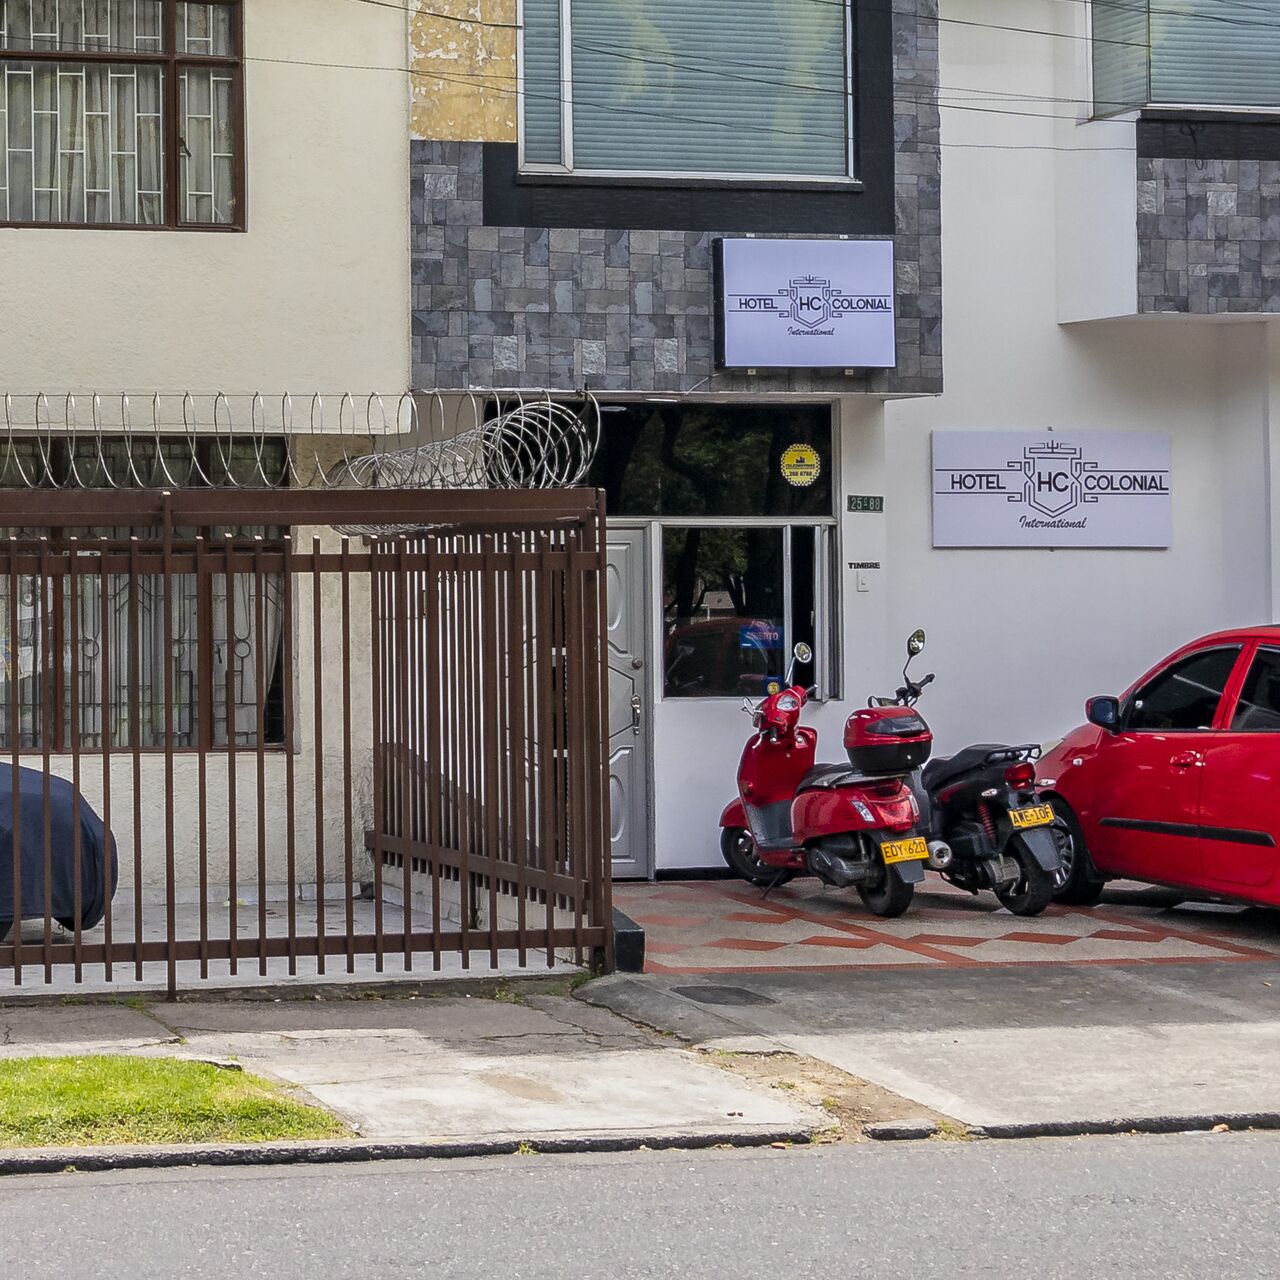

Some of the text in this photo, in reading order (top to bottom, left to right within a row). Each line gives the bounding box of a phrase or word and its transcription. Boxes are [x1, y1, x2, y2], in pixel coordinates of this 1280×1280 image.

[739, 296, 892, 311] HOTEL HC COLONIAL
[787, 326, 835, 336] International
[951, 471, 1169, 492] HOTEL HC COLONIAL
[1019, 515, 1087, 529] International
[848, 562, 881, 570] TIMBRE
